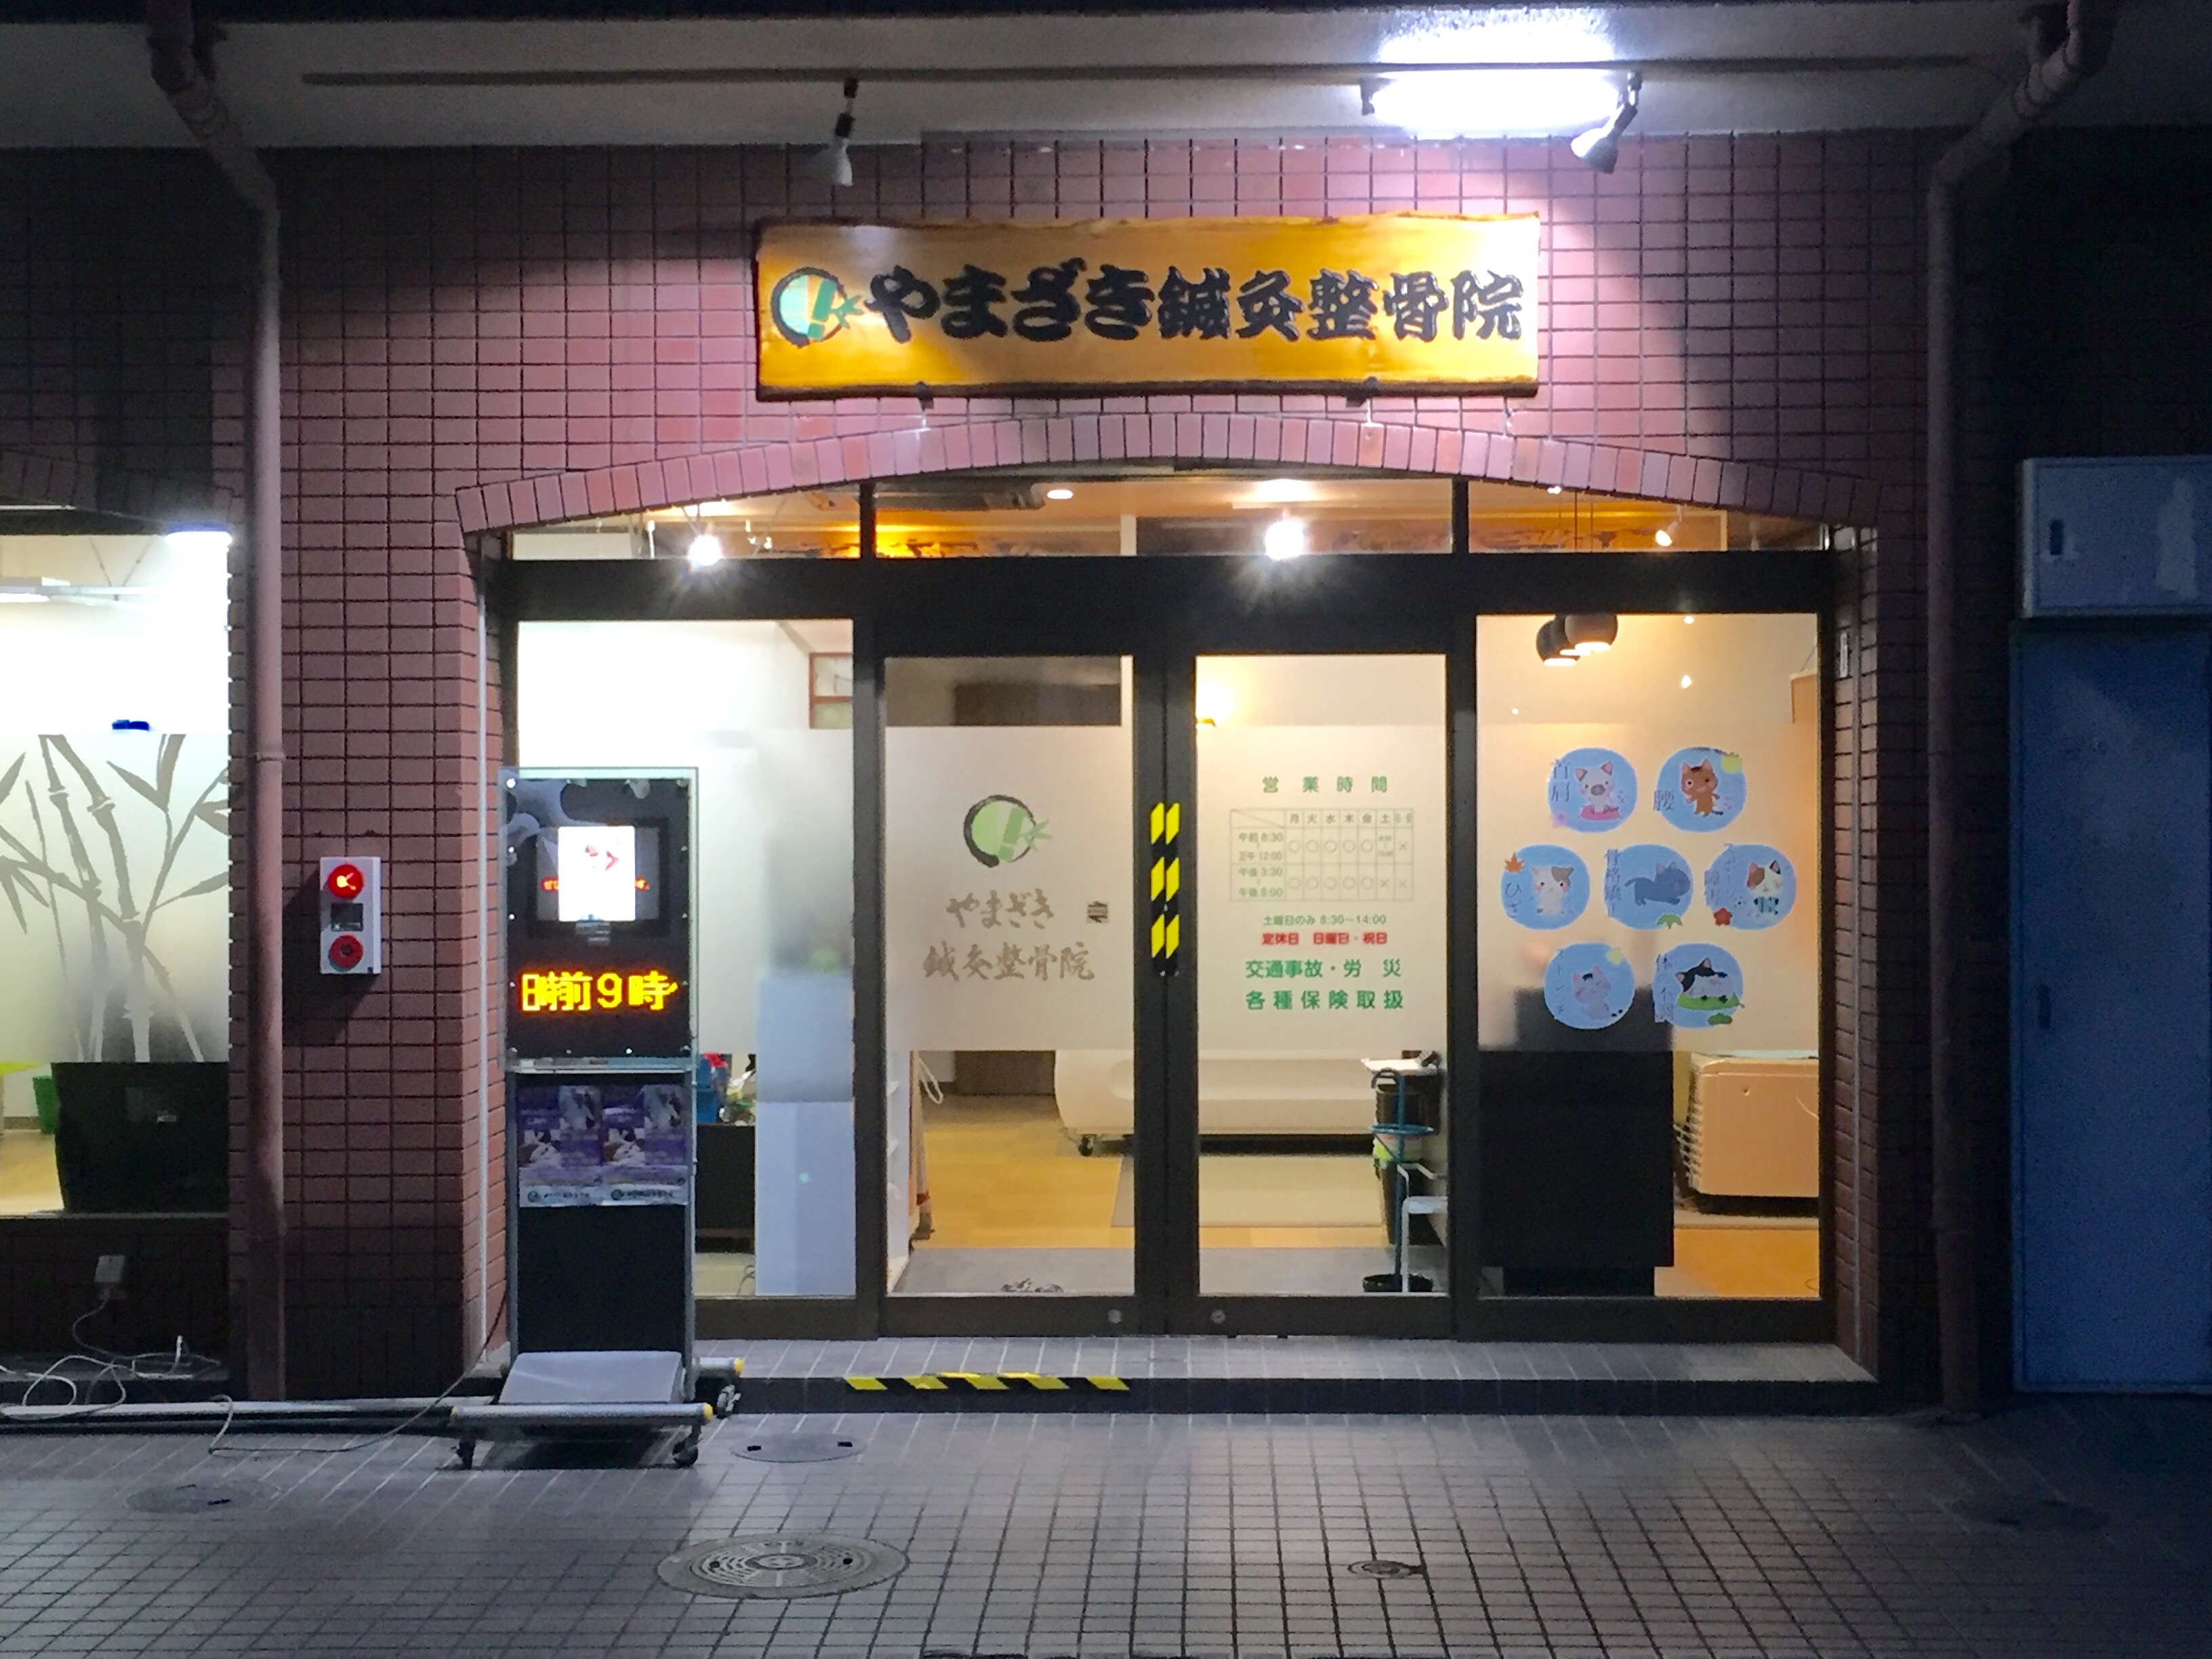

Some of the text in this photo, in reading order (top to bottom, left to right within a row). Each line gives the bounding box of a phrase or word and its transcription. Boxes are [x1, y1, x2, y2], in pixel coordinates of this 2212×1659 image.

[865, 258, 1525, 342] やまざき鍼灸整骨院
[1262, 776, 1388, 793] 営業時間
[1654, 790, 1675, 811] 腰
[946, 888, 1054, 929] やまざき
[1263, 915, 1315, 926] 土曜日のみ
[1262, 932, 1388, 945] 定休日 日曜日・祝日
[923, 940, 1095, 982] 鍼灸整骨院
[1246, 989, 1404, 1010] 各種保険取扱
